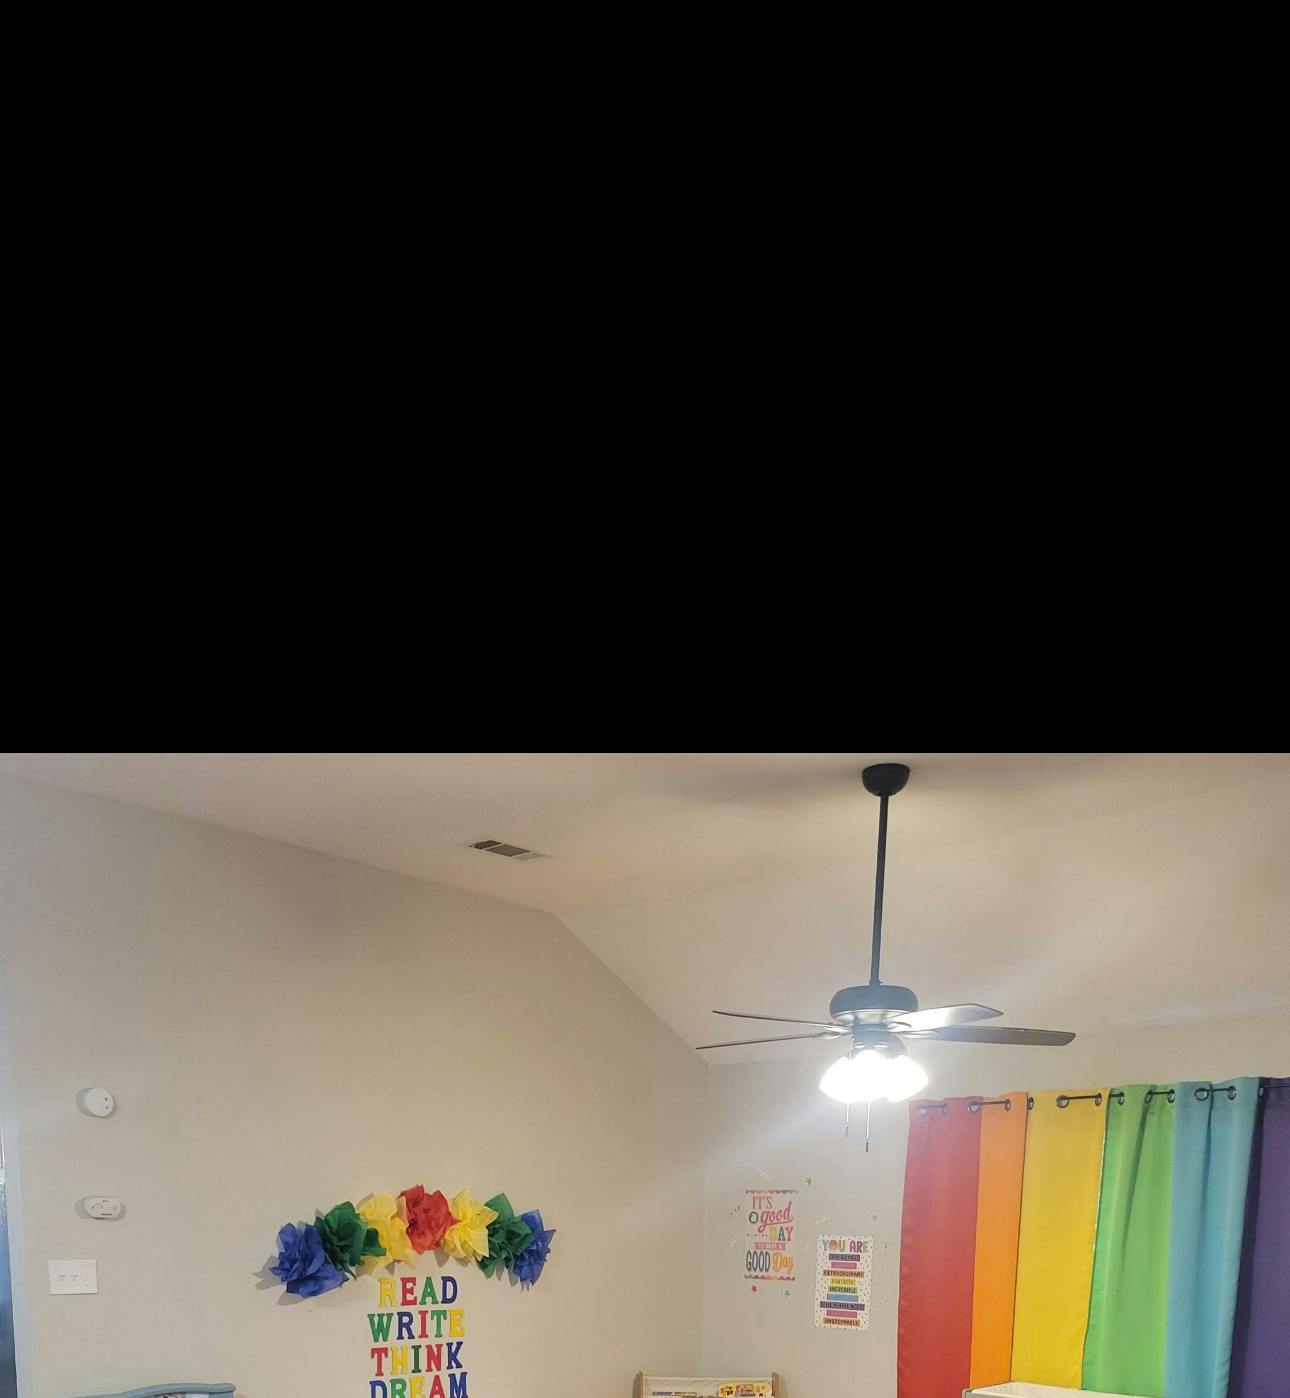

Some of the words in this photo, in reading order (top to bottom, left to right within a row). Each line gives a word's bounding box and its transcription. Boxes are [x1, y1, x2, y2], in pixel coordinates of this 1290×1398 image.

[752, 1195, 773, 1210] IT'S
[748, 1211, 759, 1224] a
[757, 1201, 794, 1233] good
[768, 1226, 794, 1242] DAY
[822, 1239, 846, 1253] YOU
[849, 1240, 869, 1254] ARE
[746, 1250, 771, 1272] GOOD
[772, 1252, 794, 1275] Day
[378, 1276, 458, 1308] READ
[367, 1309, 465, 1343] WRITE
[370, 1341, 464, 1377] THINK
